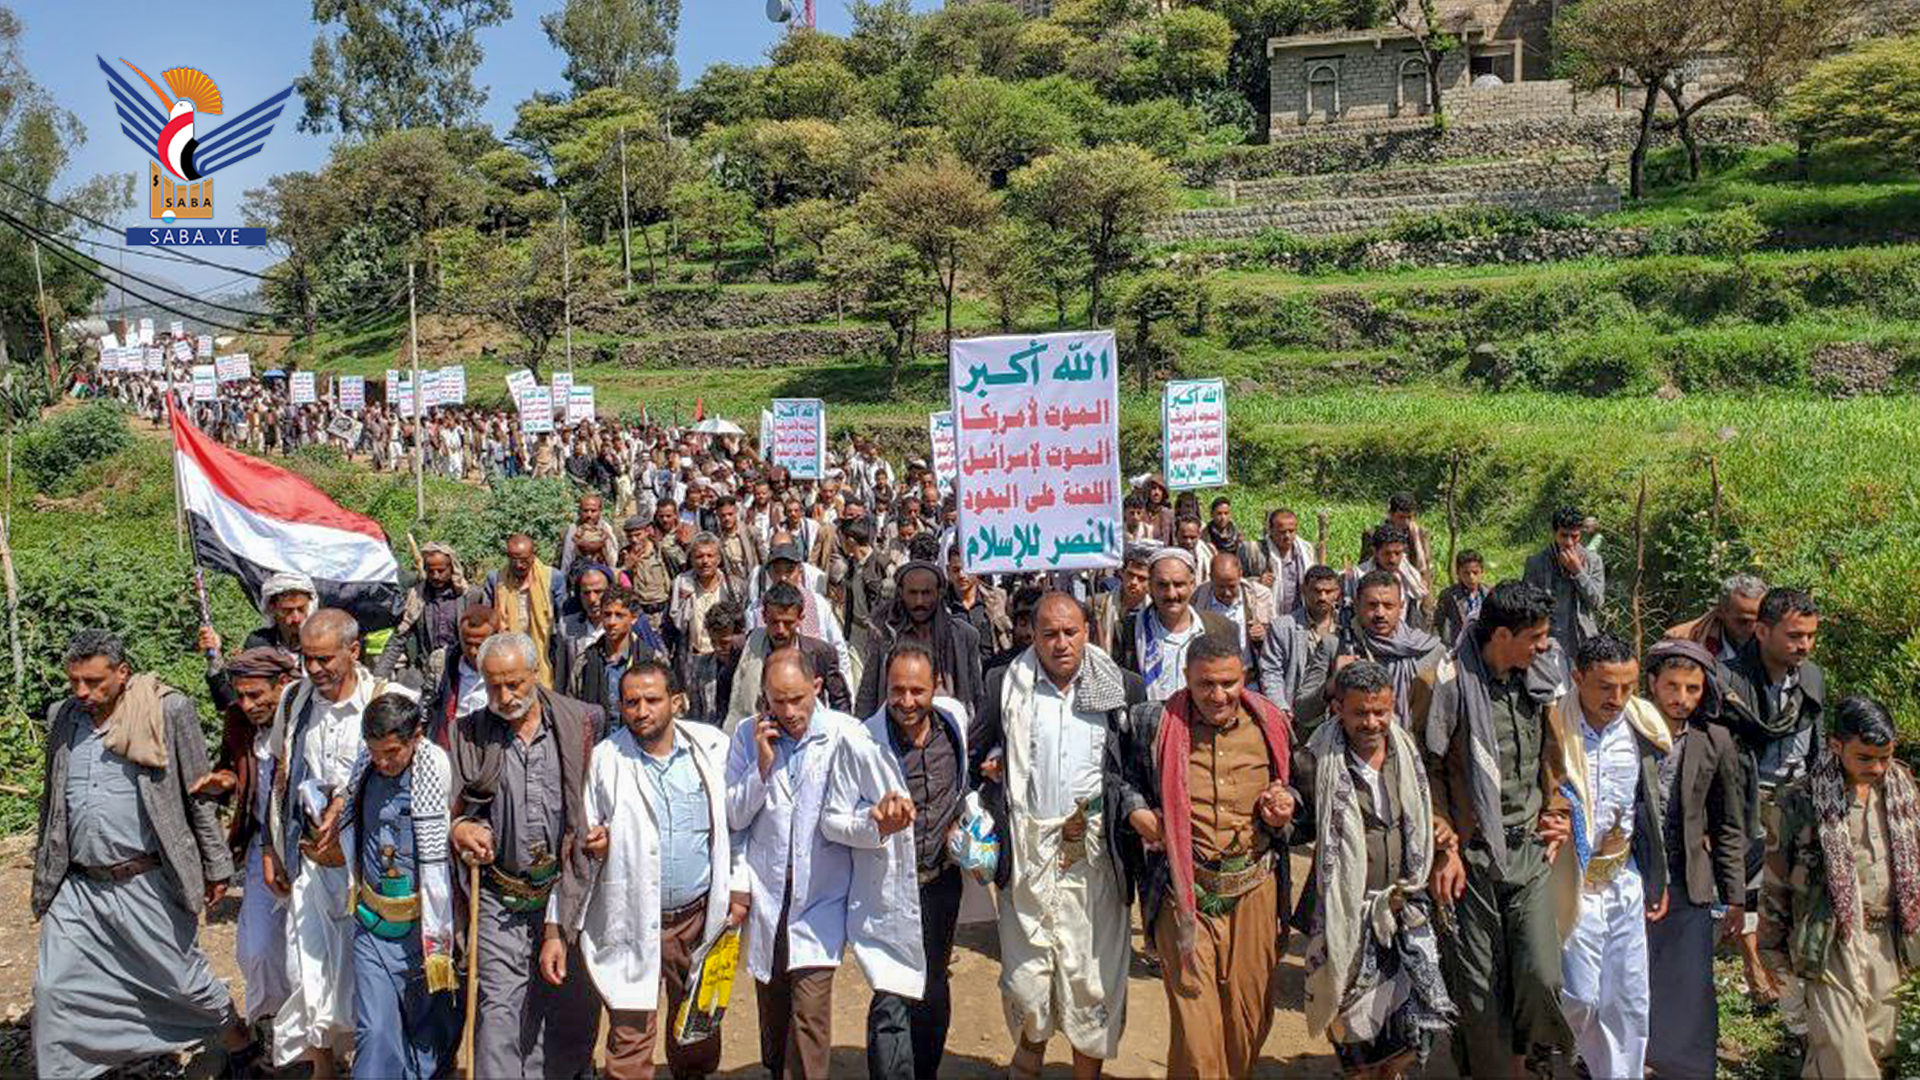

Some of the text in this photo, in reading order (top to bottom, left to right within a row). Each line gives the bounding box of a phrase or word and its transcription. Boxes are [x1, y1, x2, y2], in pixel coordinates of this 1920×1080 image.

[957, 340, 1109, 398] الله أكبر
[961, 396, 1109, 436] الموت لأمريكا
[963, 437, 1111, 476] الموت لإسرائيل
[964, 479, 1112, 515] اللعنة على اليهود
[966, 517, 1115, 569] النصر للإسلام
